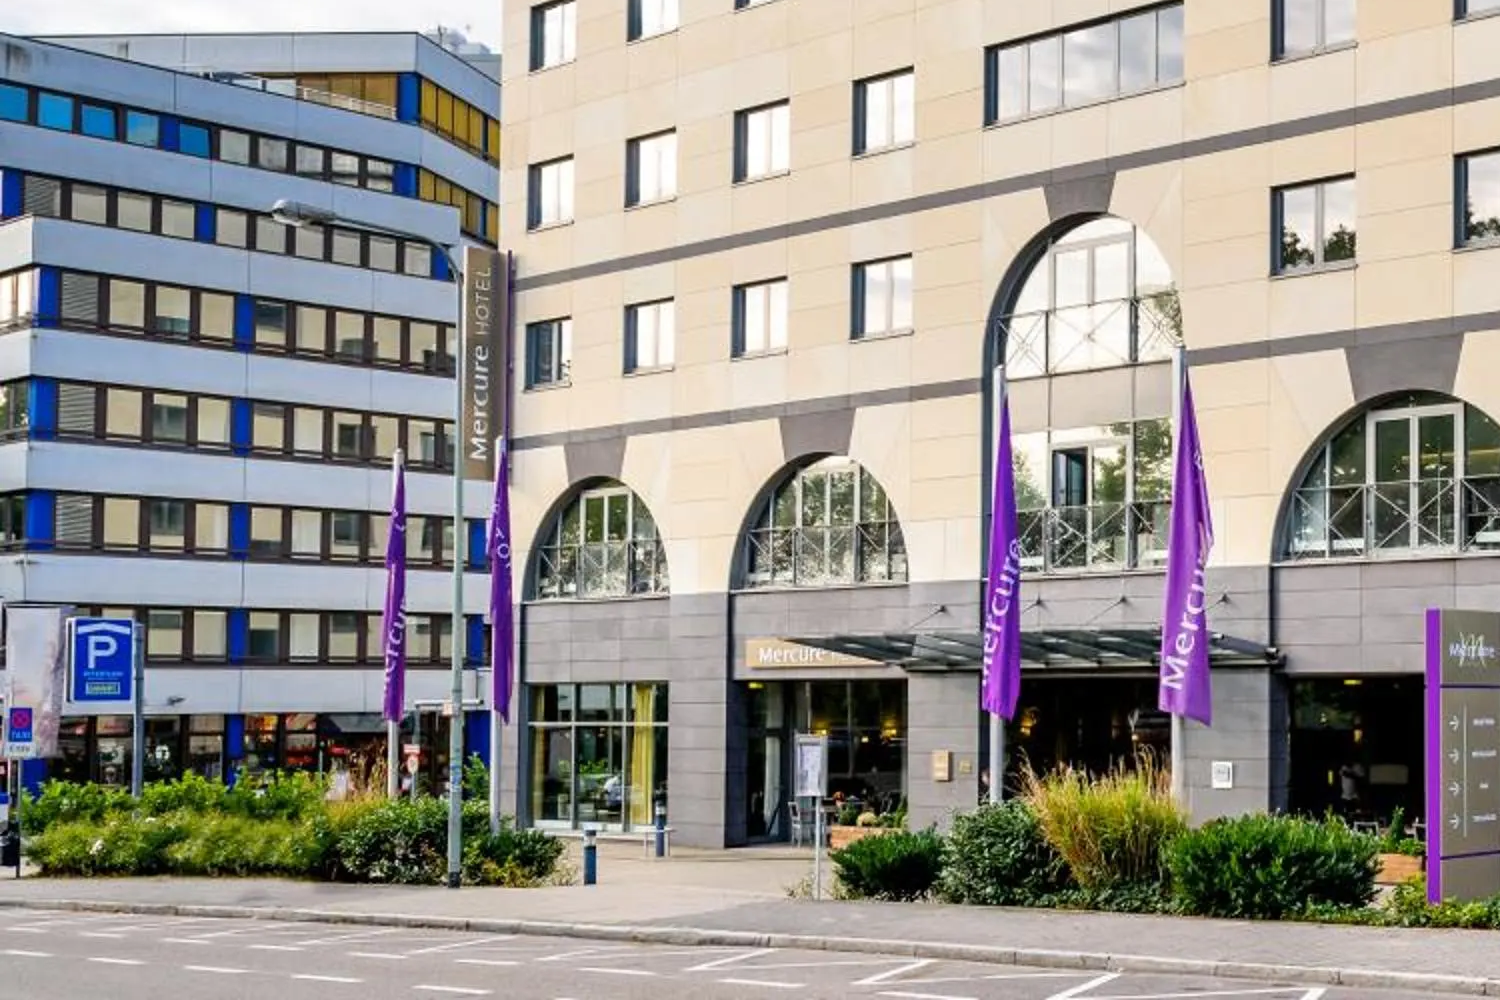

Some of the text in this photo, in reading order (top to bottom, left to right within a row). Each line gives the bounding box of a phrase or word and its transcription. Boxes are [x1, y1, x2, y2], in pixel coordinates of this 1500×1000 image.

[469, 267, 492, 461] Mercure HOTEL
[88, 635, 118, 669] P
[758, 646, 826, 664] Mercure
